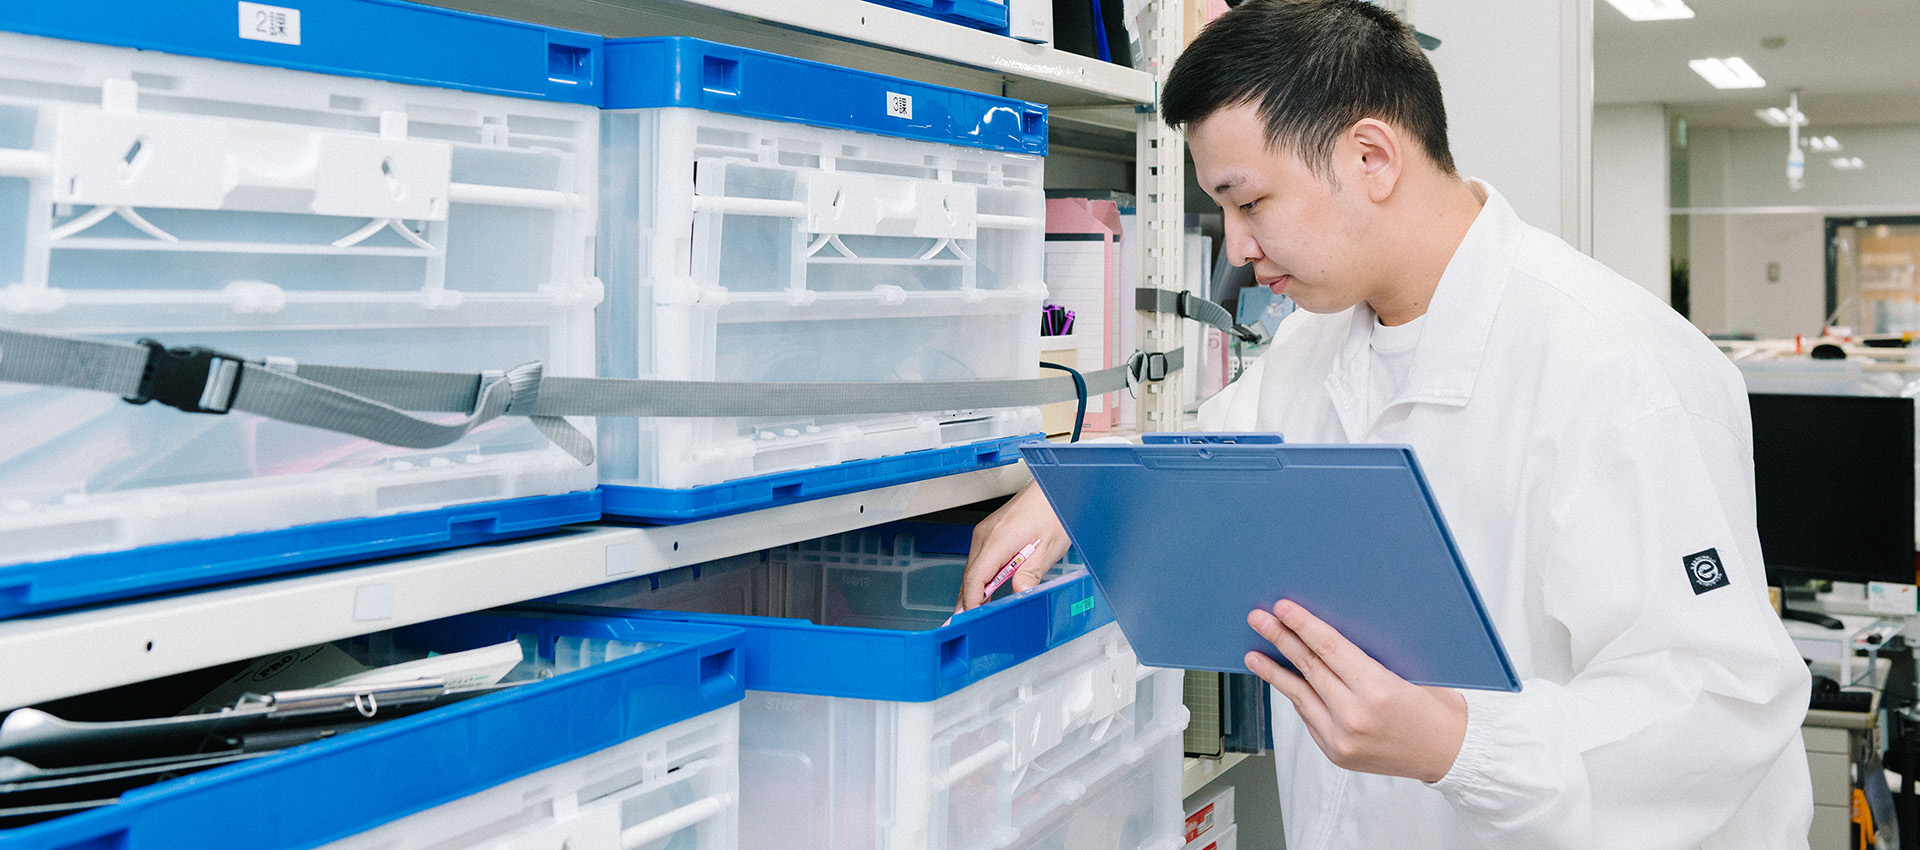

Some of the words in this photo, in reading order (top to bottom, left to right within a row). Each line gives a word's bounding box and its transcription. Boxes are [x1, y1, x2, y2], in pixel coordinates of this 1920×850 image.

[255, 10, 288, 37] 2課
[893, 96, 907, 114] 3課
[258, 655, 293, 677] PRO
